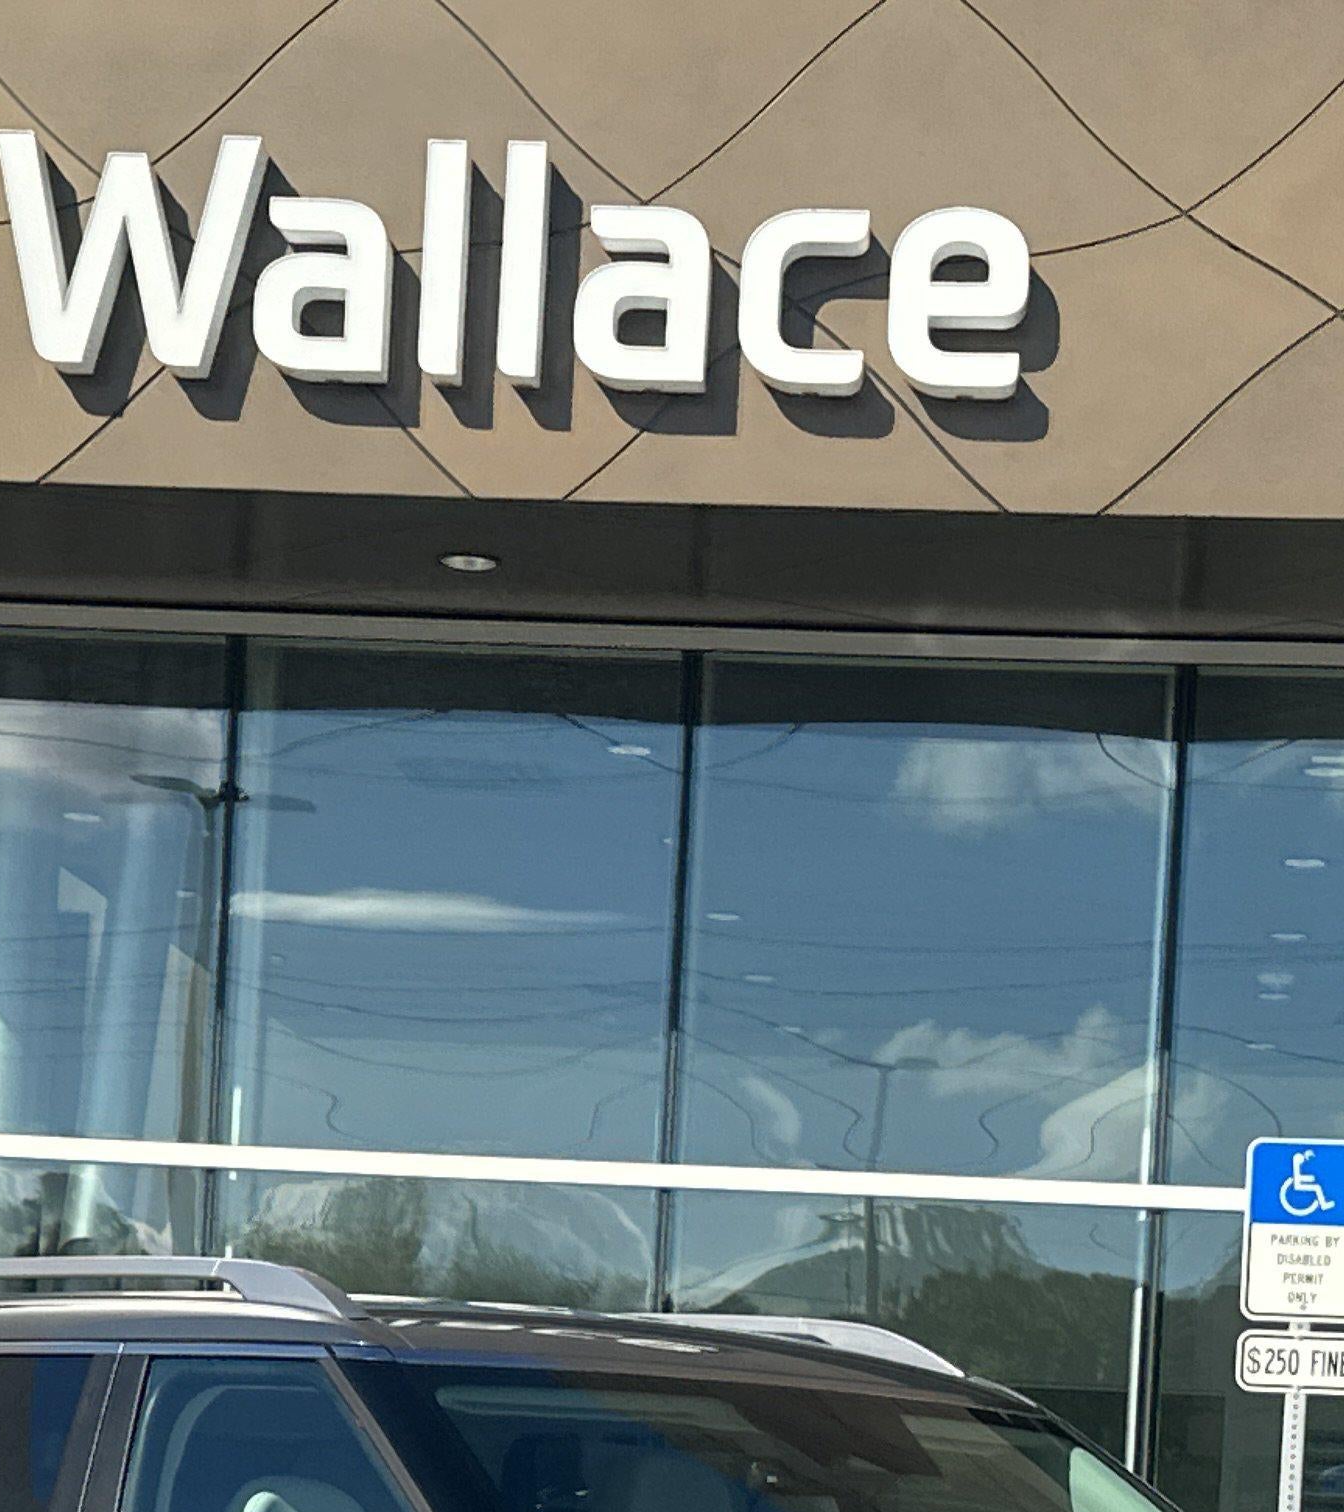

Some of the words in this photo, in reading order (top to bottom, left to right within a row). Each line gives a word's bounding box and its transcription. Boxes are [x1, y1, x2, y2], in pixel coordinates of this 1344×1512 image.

[1270, 1233, 1319, 1246] PARKING
[1325, 1235, 1340, 1247] BY
[1276, 1253, 1331, 1266] DISABLED
[1283, 1271, 1323, 1284] PERMIT
[1287, 1291, 1317, 1303] ONLY
[1246, 1345, 1299, 1375] $250
